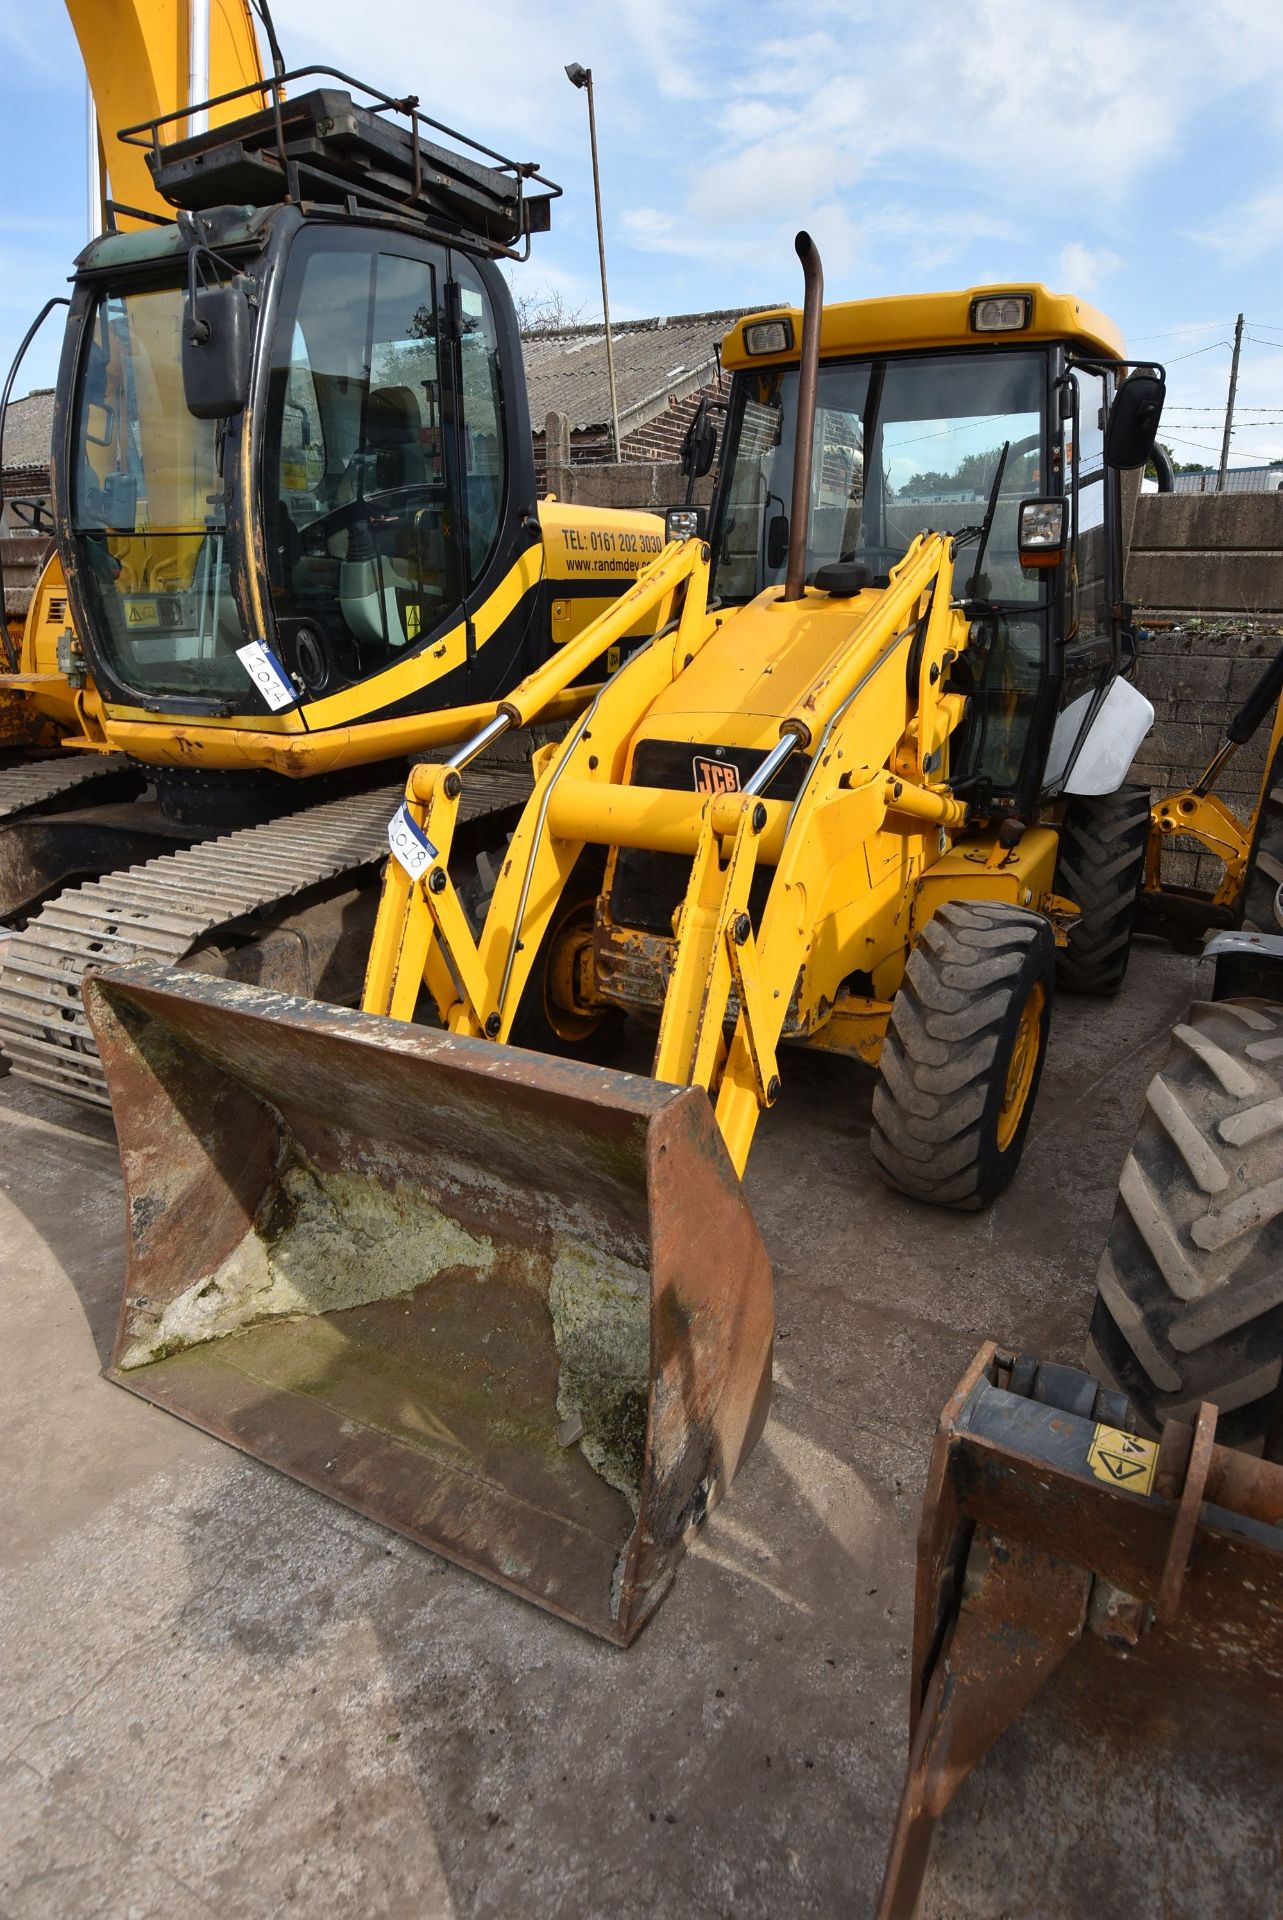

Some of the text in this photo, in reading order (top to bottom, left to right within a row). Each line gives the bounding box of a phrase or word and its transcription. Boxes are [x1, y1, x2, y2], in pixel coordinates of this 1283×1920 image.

[562, 529, 663, 553] TEL: 0161 202 3030
[699, 762, 736, 794] JCB
